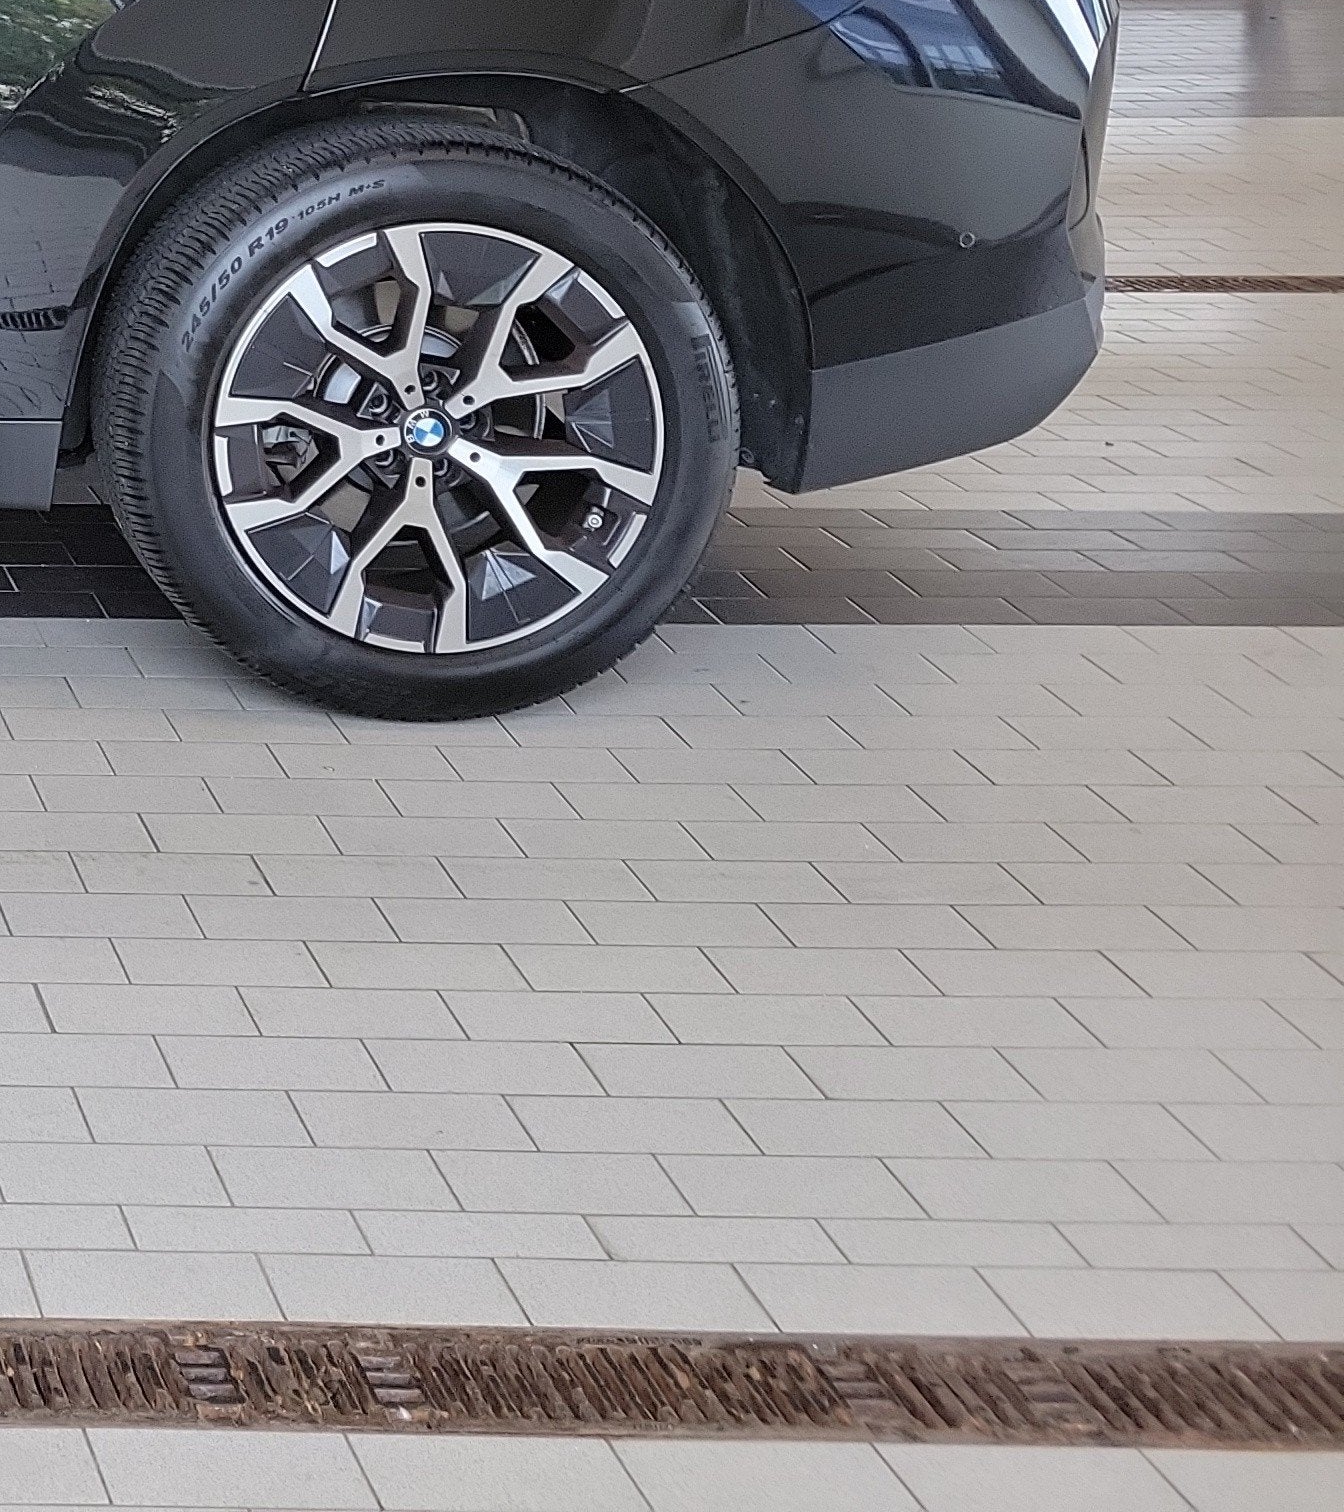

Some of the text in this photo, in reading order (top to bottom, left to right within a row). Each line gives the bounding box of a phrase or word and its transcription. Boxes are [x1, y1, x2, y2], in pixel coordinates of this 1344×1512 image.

[181, 255, 244, 354] 245/50
[247, 216, 290, 258] R19
[297, 192, 341, 221] 105H
